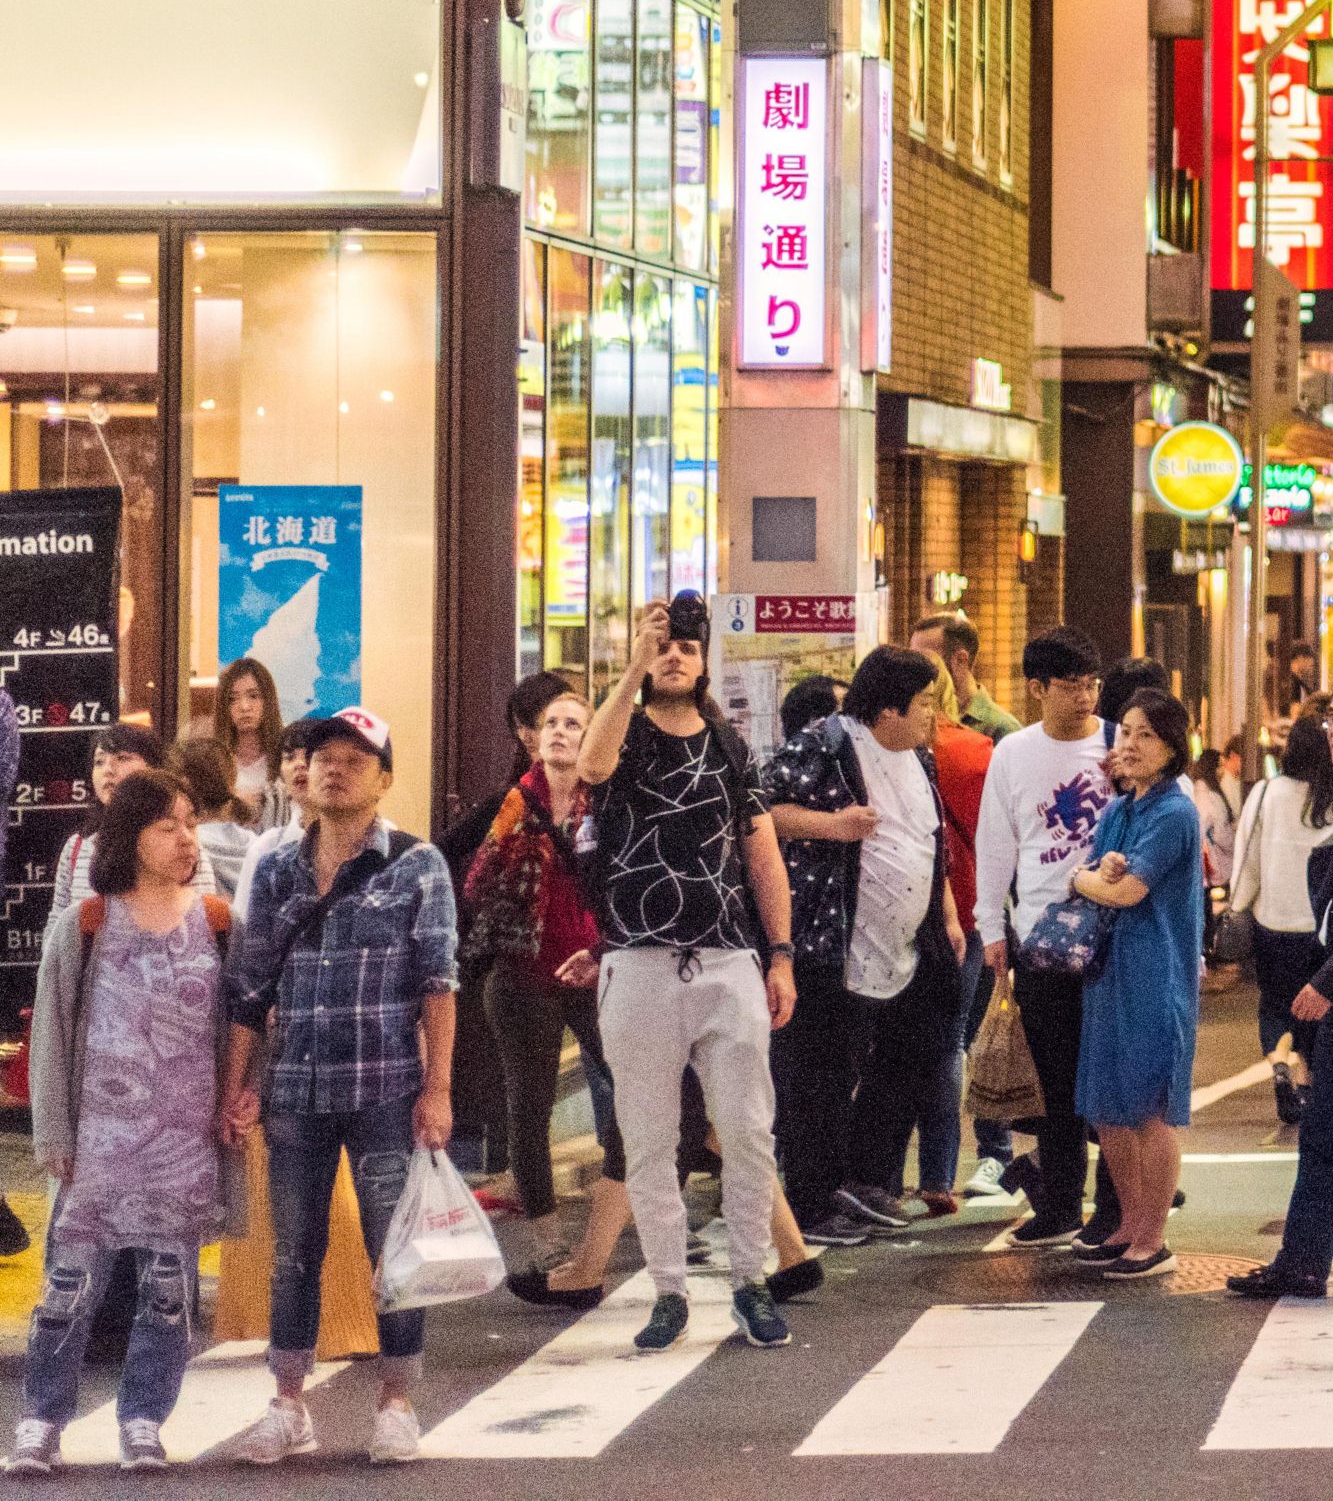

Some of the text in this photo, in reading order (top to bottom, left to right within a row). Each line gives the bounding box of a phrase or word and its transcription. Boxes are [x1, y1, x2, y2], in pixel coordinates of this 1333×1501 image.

[761, 81, 810, 338] 劇場通り
[242, 515, 338, 546] 北海道
[13, 631, 42, 649] 4F
[15, 705, 44, 726] 3F
[16, 783, 45, 804] 2F
[24, 861, 45, 880] 1F
